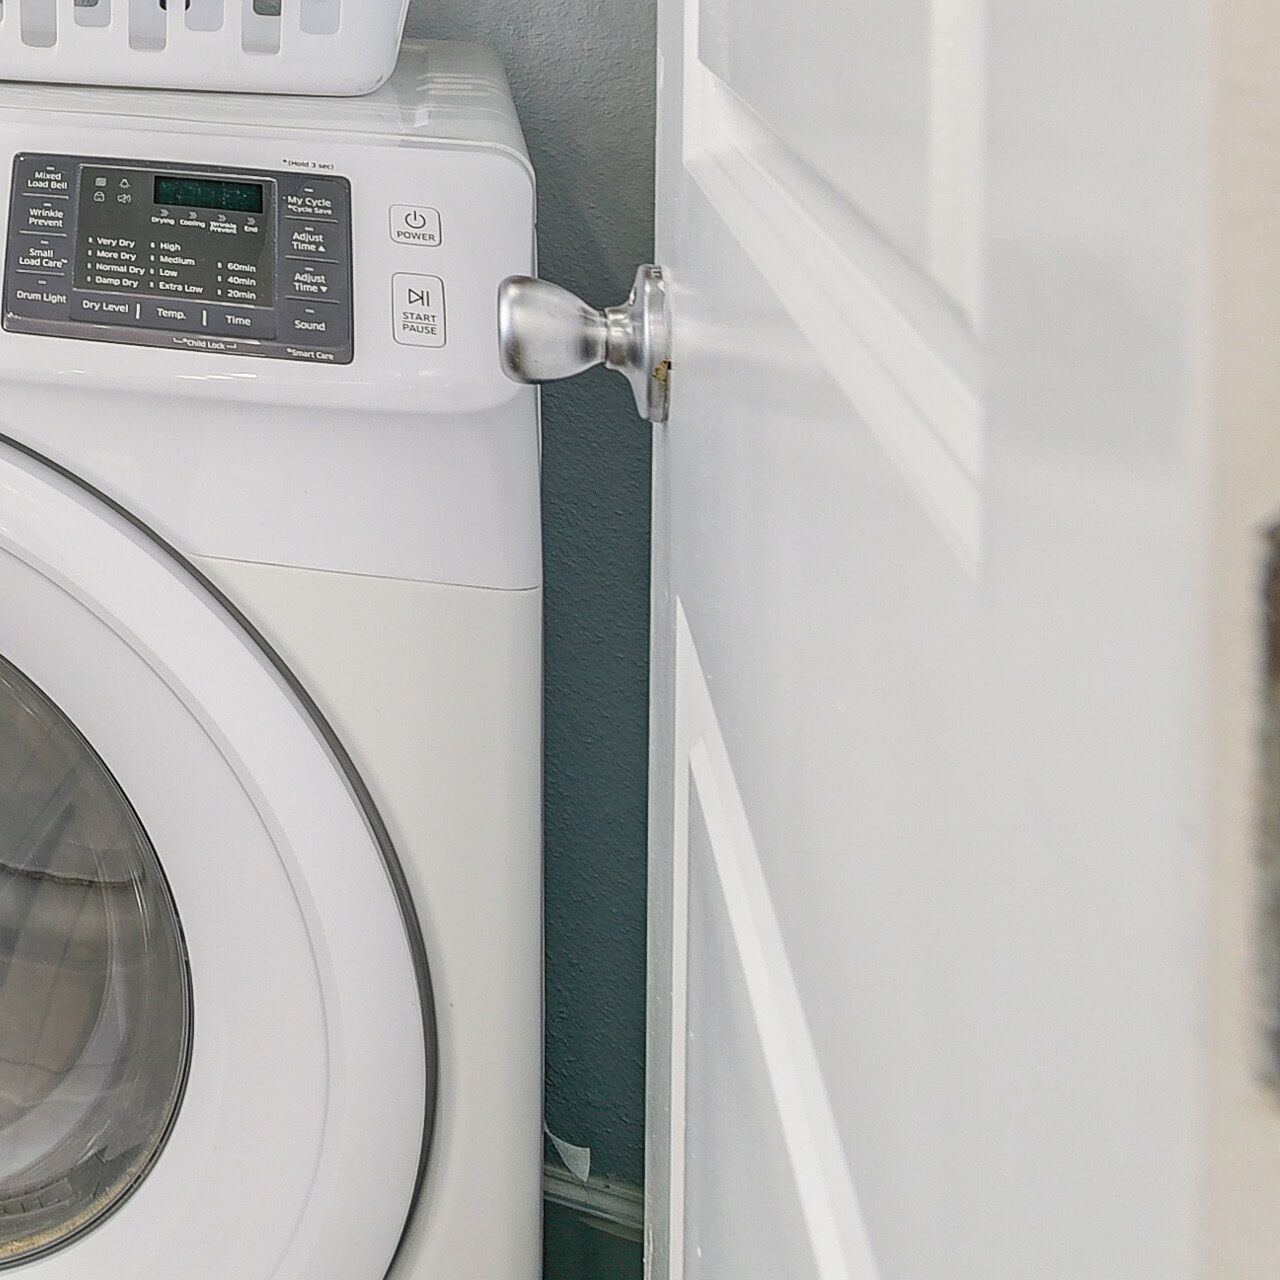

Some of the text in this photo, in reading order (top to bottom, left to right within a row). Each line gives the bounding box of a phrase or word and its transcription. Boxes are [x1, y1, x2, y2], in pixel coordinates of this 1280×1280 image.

[34, 172, 61, 180] Mixed
[27, 179, 67, 189] Load Bell
[287, 196, 332, 208] My Cycle
[29, 208, 63, 218] Wrinkle
[314, 207, 332, 215] Save
[28, 217, 63, 227] Prevent
[151, 215, 175, 226] Drying
[179, 219, 206, 228] Cooling
[244, 225, 258, 233] End
[292, 232, 324, 243] Adjust
[396, 230, 436, 242] POWER
[96, 237, 135, 248] Very Dry
[160, 242, 181, 252] High
[292, 241, 316, 252] Time
[29, 248, 53, 258] Small
[96, 250, 136, 261] More Dry
[19, 257, 40, 266] Load
[160, 255, 195, 266] Medium
[96, 263, 145, 276] Normal Dry
[159, 268, 178, 277] Low
[227, 262, 256, 273] 60min
[95, 276, 138, 288] Damp Dry
[227, 276, 256, 286] 40min
[294, 273, 326, 284] Adjust
[159, 282, 203, 294] Extra Low
[294, 282, 318, 293] Time
[16, 291, 67, 303] Drum Light
[227, 289, 256, 300] 20min
[82, 300, 129, 313] Dry Level
[156, 308, 186, 319] Temp.
[402, 311, 437, 322] START
[225, 315, 251, 326] Time
[295, 319, 326, 331] Sound
[402, 323, 438, 335] PAUSE
[208, 341, 225, 350] Lock
[316, 350, 334, 360] Care
